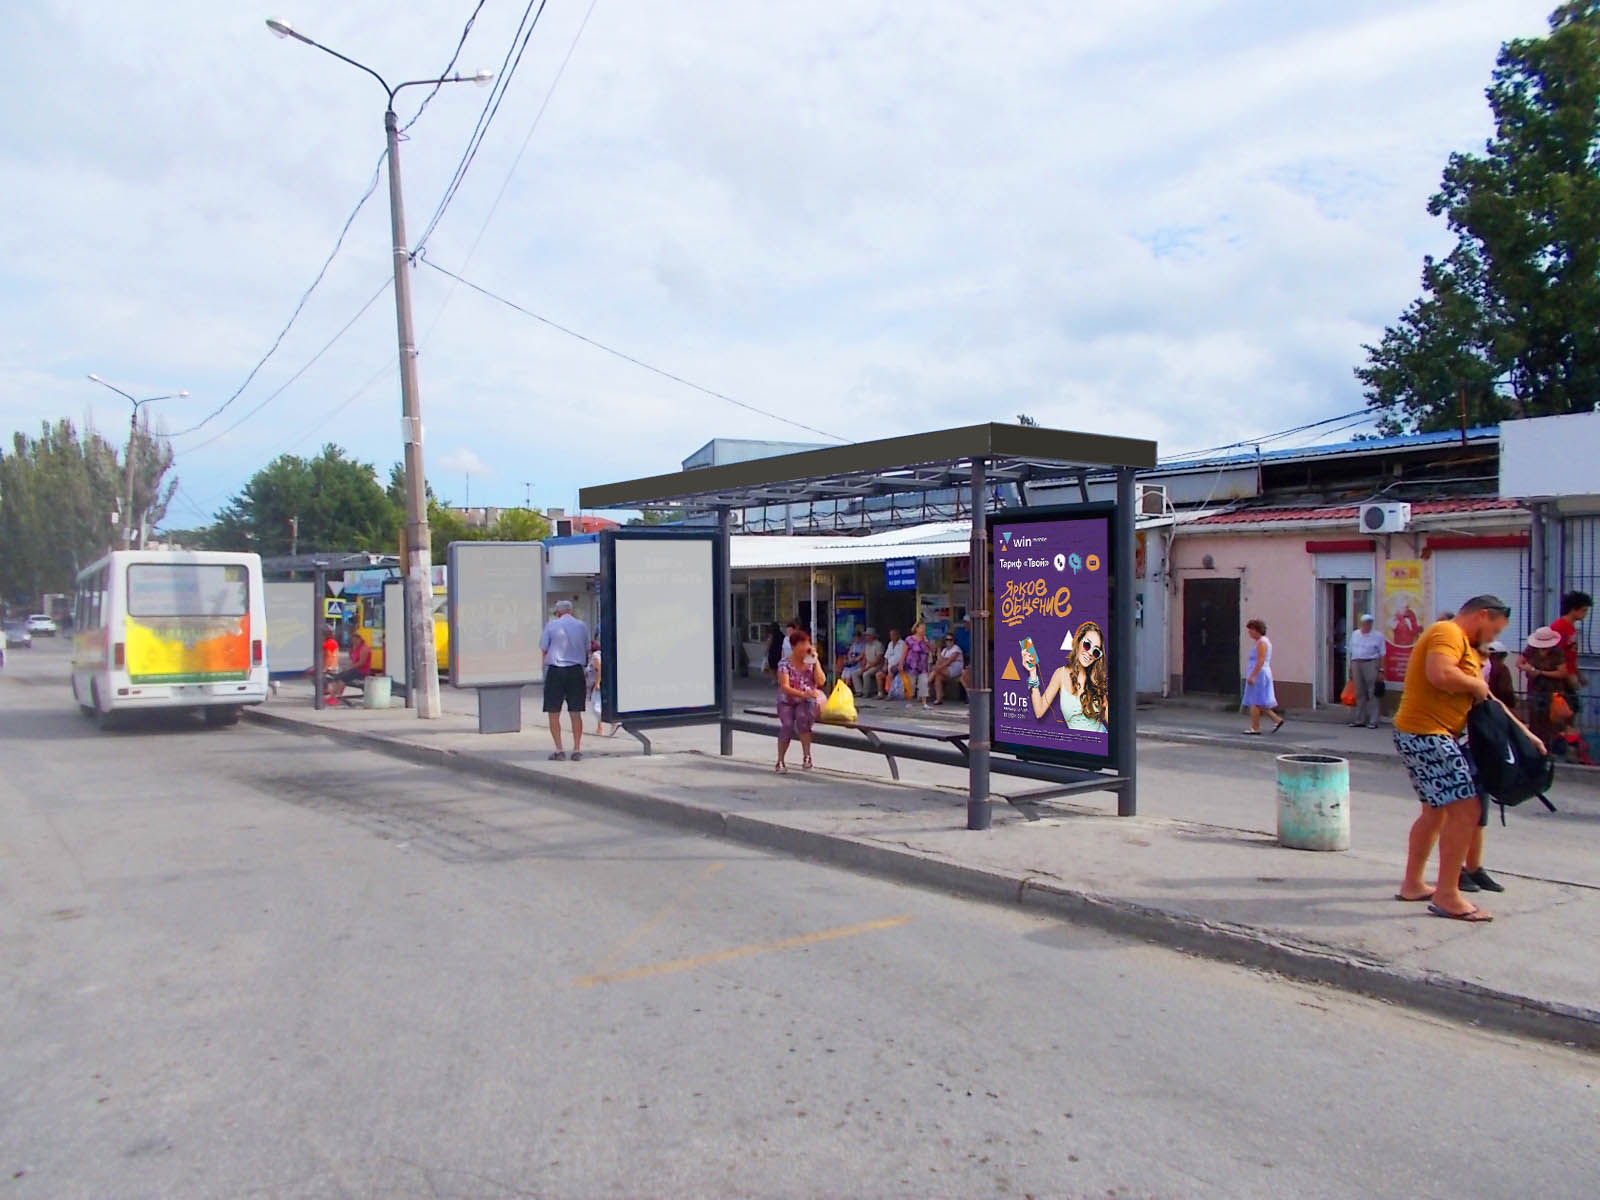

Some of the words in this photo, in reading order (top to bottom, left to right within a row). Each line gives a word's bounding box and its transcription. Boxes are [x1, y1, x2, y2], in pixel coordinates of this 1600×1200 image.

[1013, 536, 1032, 547] win
[999, 558, 1022, 570] Тариф
[1003, 691, 1017, 706] 10
[1018, 697, 1028, 707] ГБ
